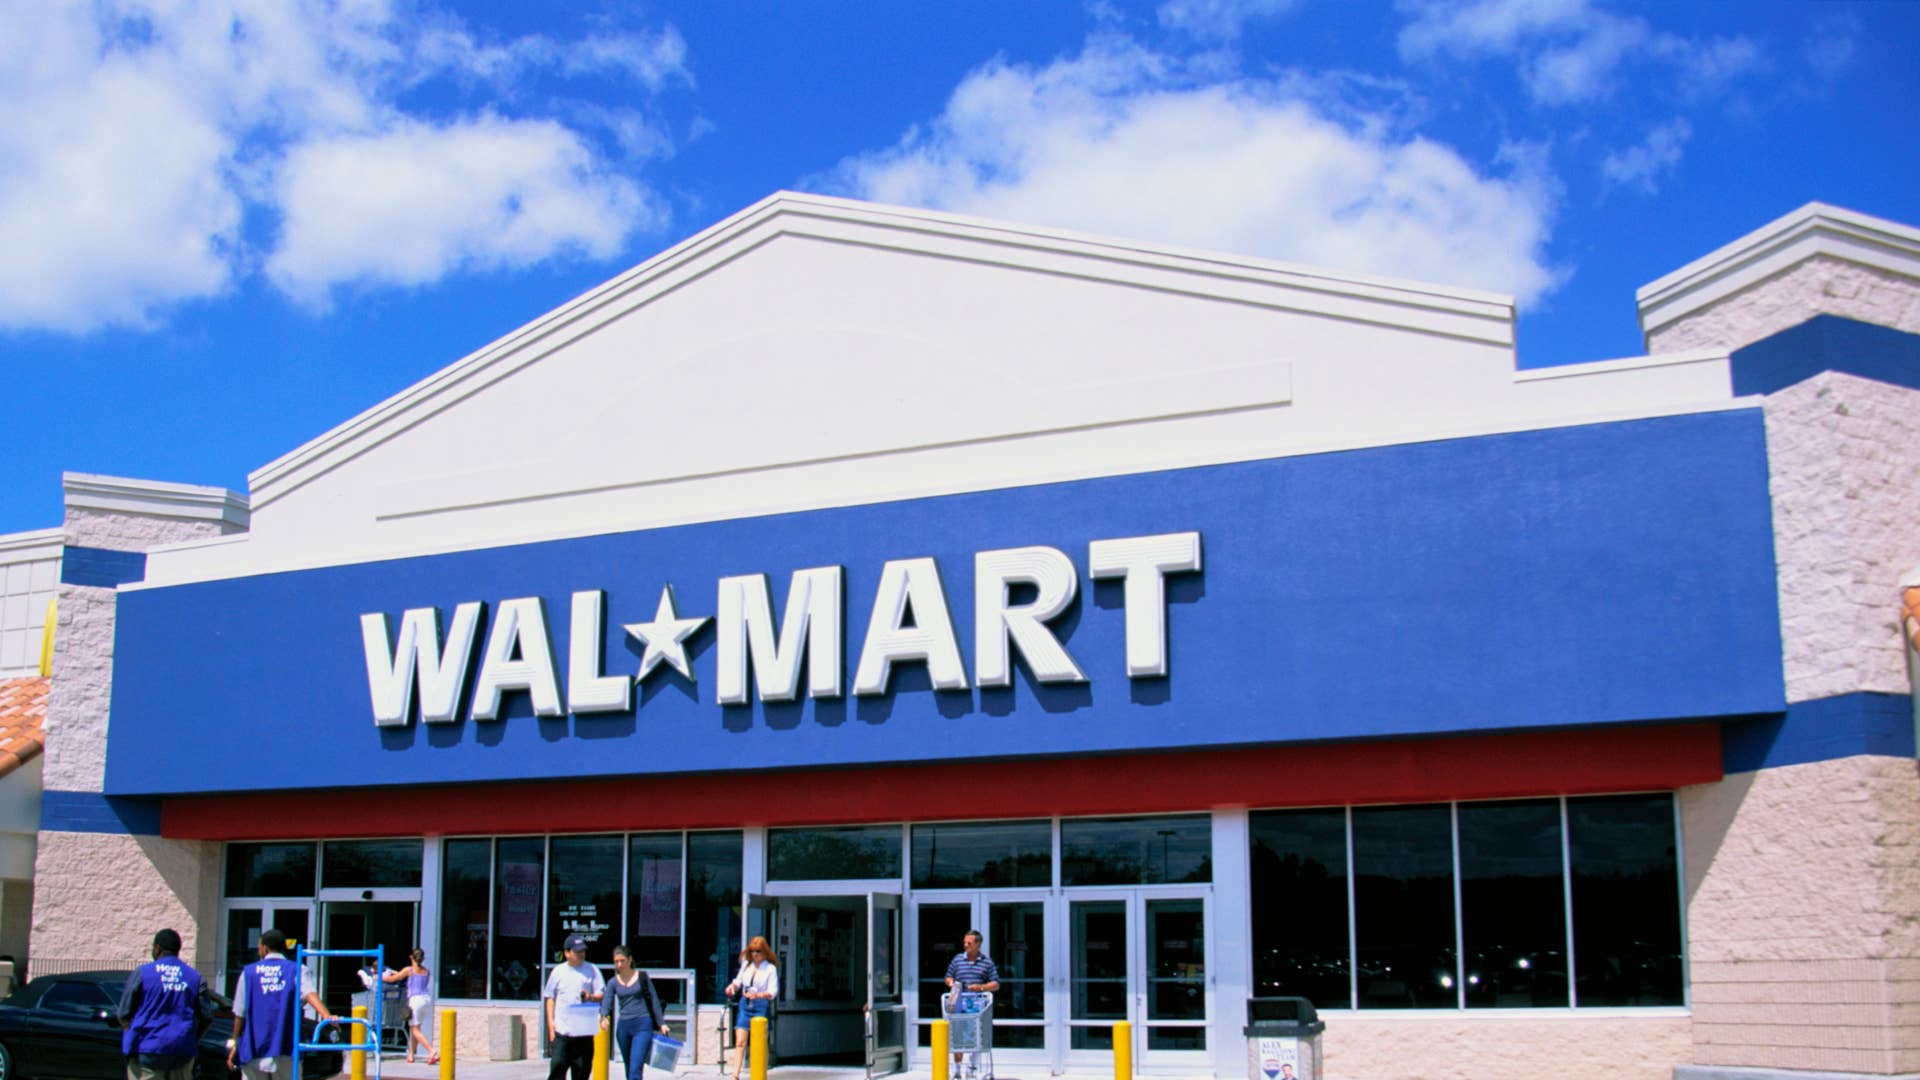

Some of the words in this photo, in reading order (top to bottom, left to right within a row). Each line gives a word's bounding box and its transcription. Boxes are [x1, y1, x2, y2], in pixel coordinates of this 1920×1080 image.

[156, 963, 180, 972] How
[256, 964, 281, 974] How
[162, 981, 188, 992] you?
[261, 980, 286, 994] you?
